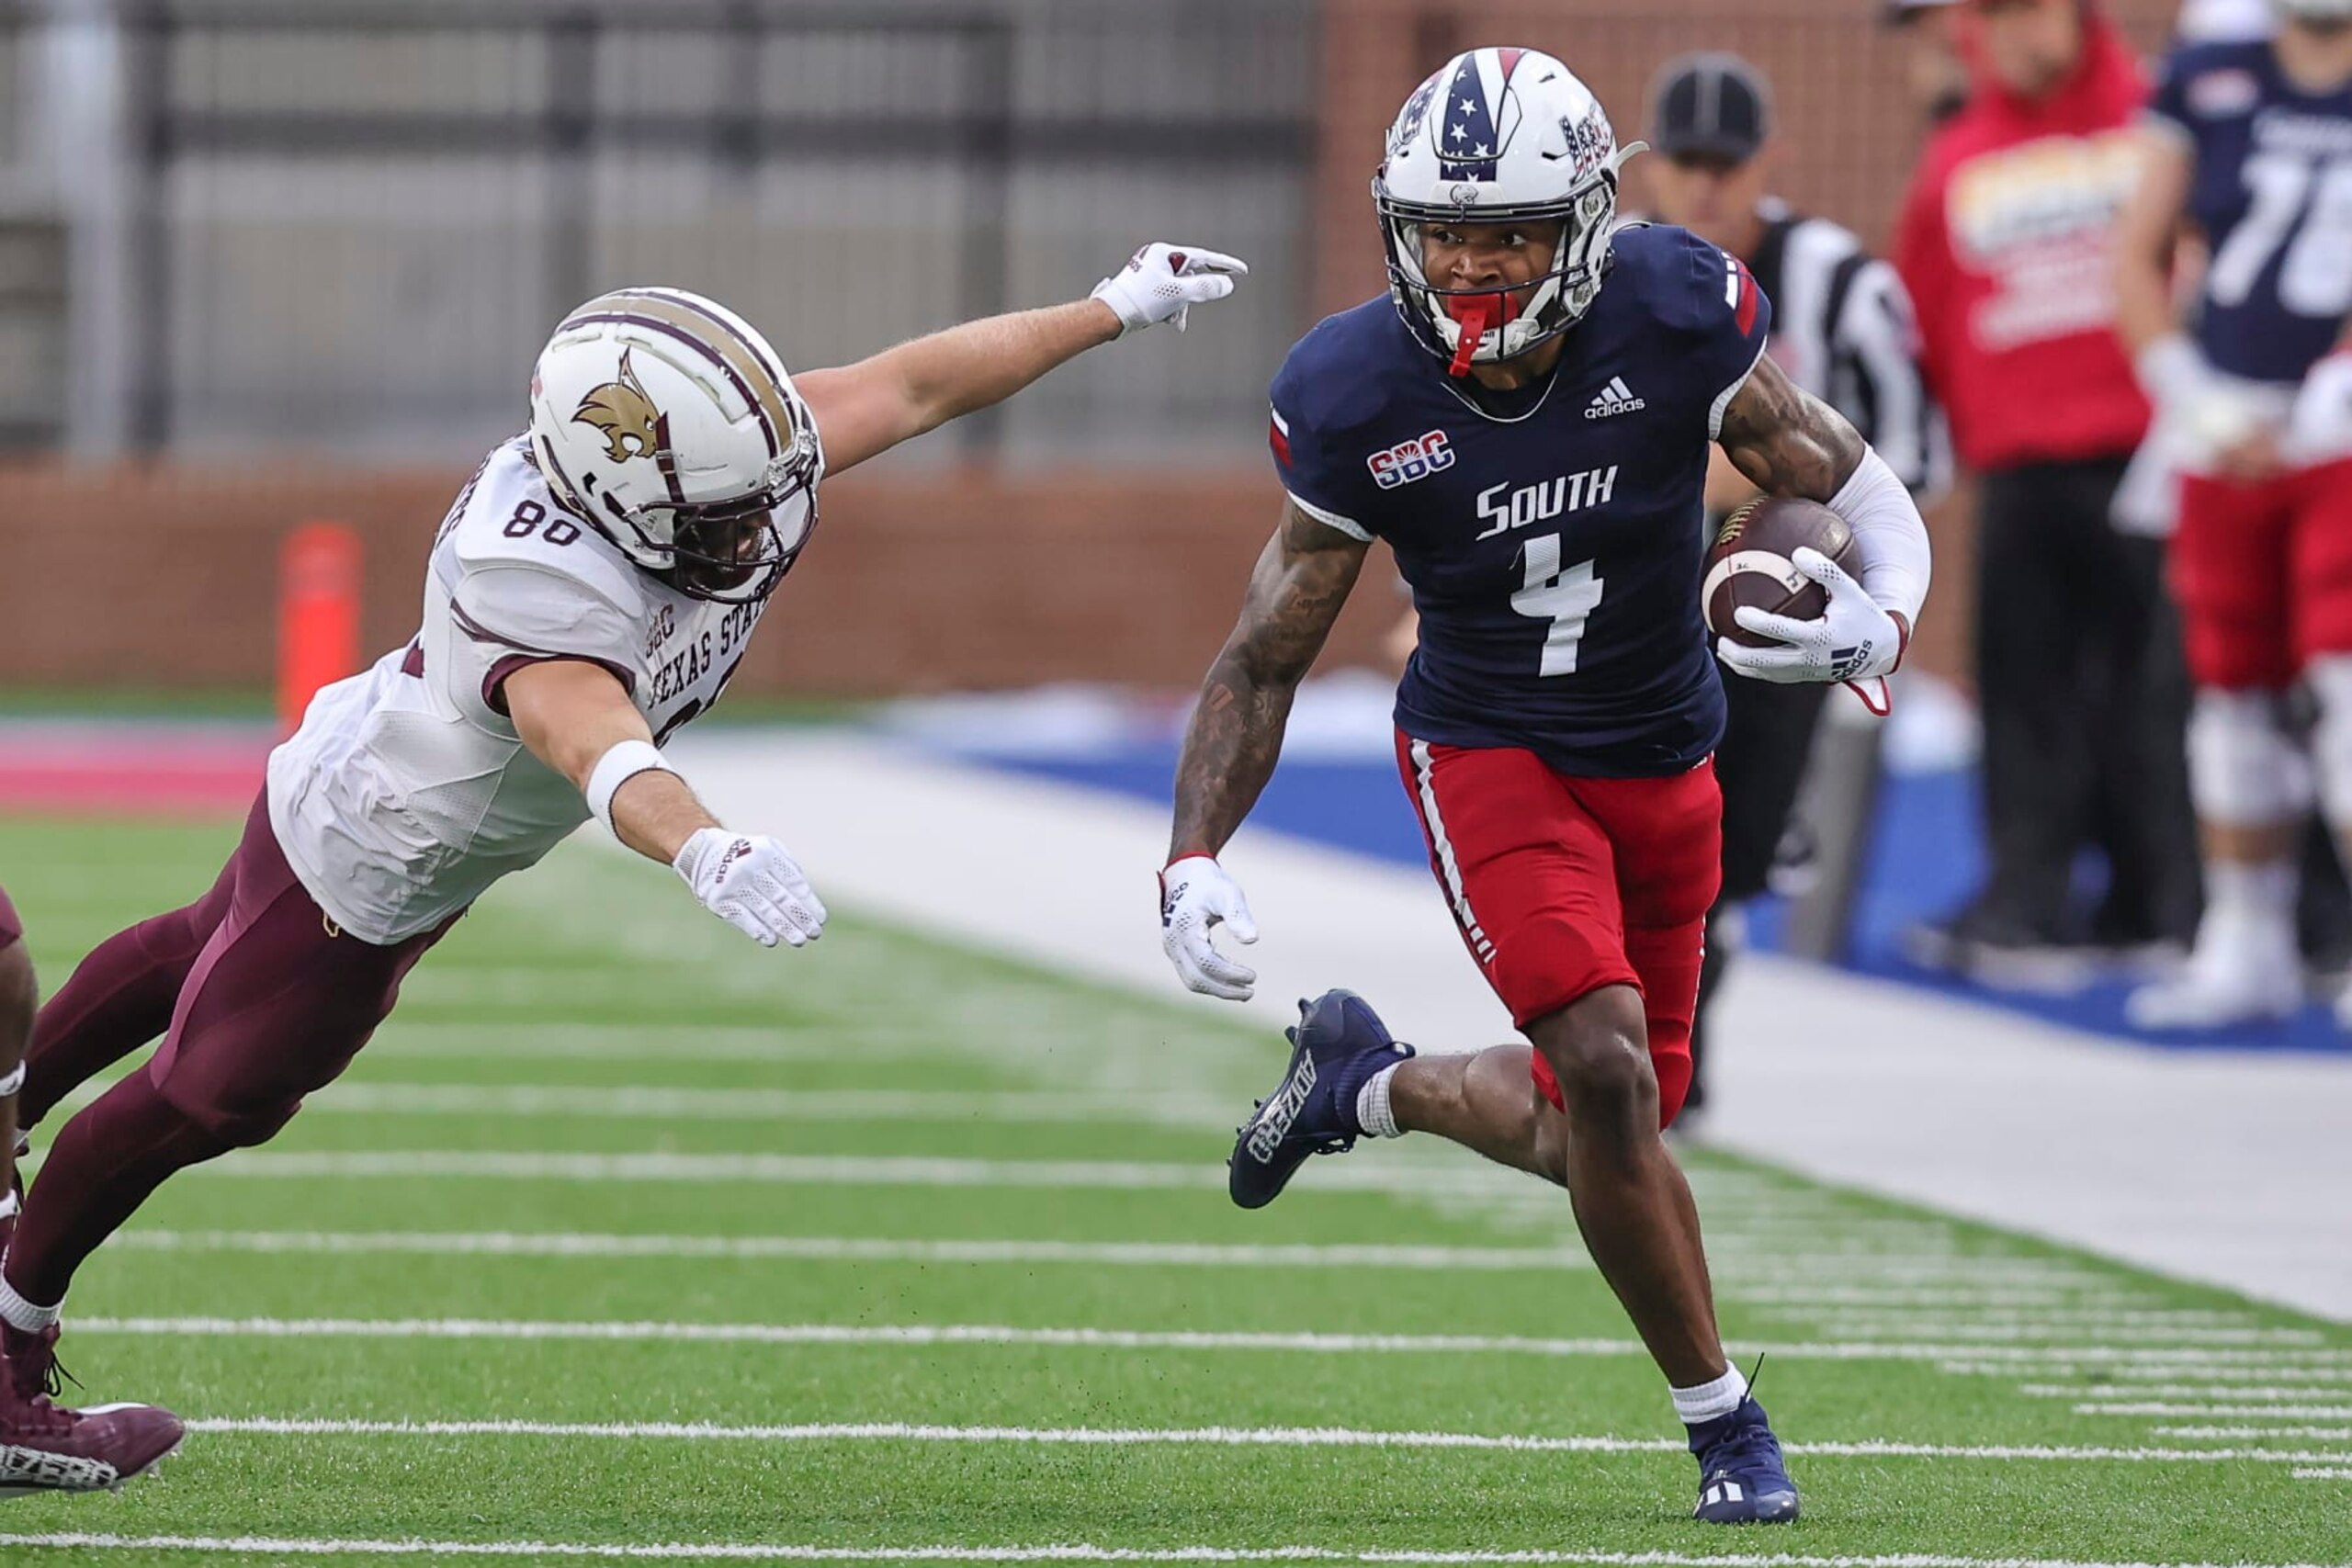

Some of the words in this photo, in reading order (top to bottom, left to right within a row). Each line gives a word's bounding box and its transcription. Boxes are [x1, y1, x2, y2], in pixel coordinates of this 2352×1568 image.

[1585, 397, 1645, 420] adidas
[1367, 429, 1456, 490] SBC
[503, 500, 582, 547] 80
[1476, 465, 1619, 542] SOUTH
[1510, 532, 1605, 678] 4
[647, 631, 711, 711] TEXAS
